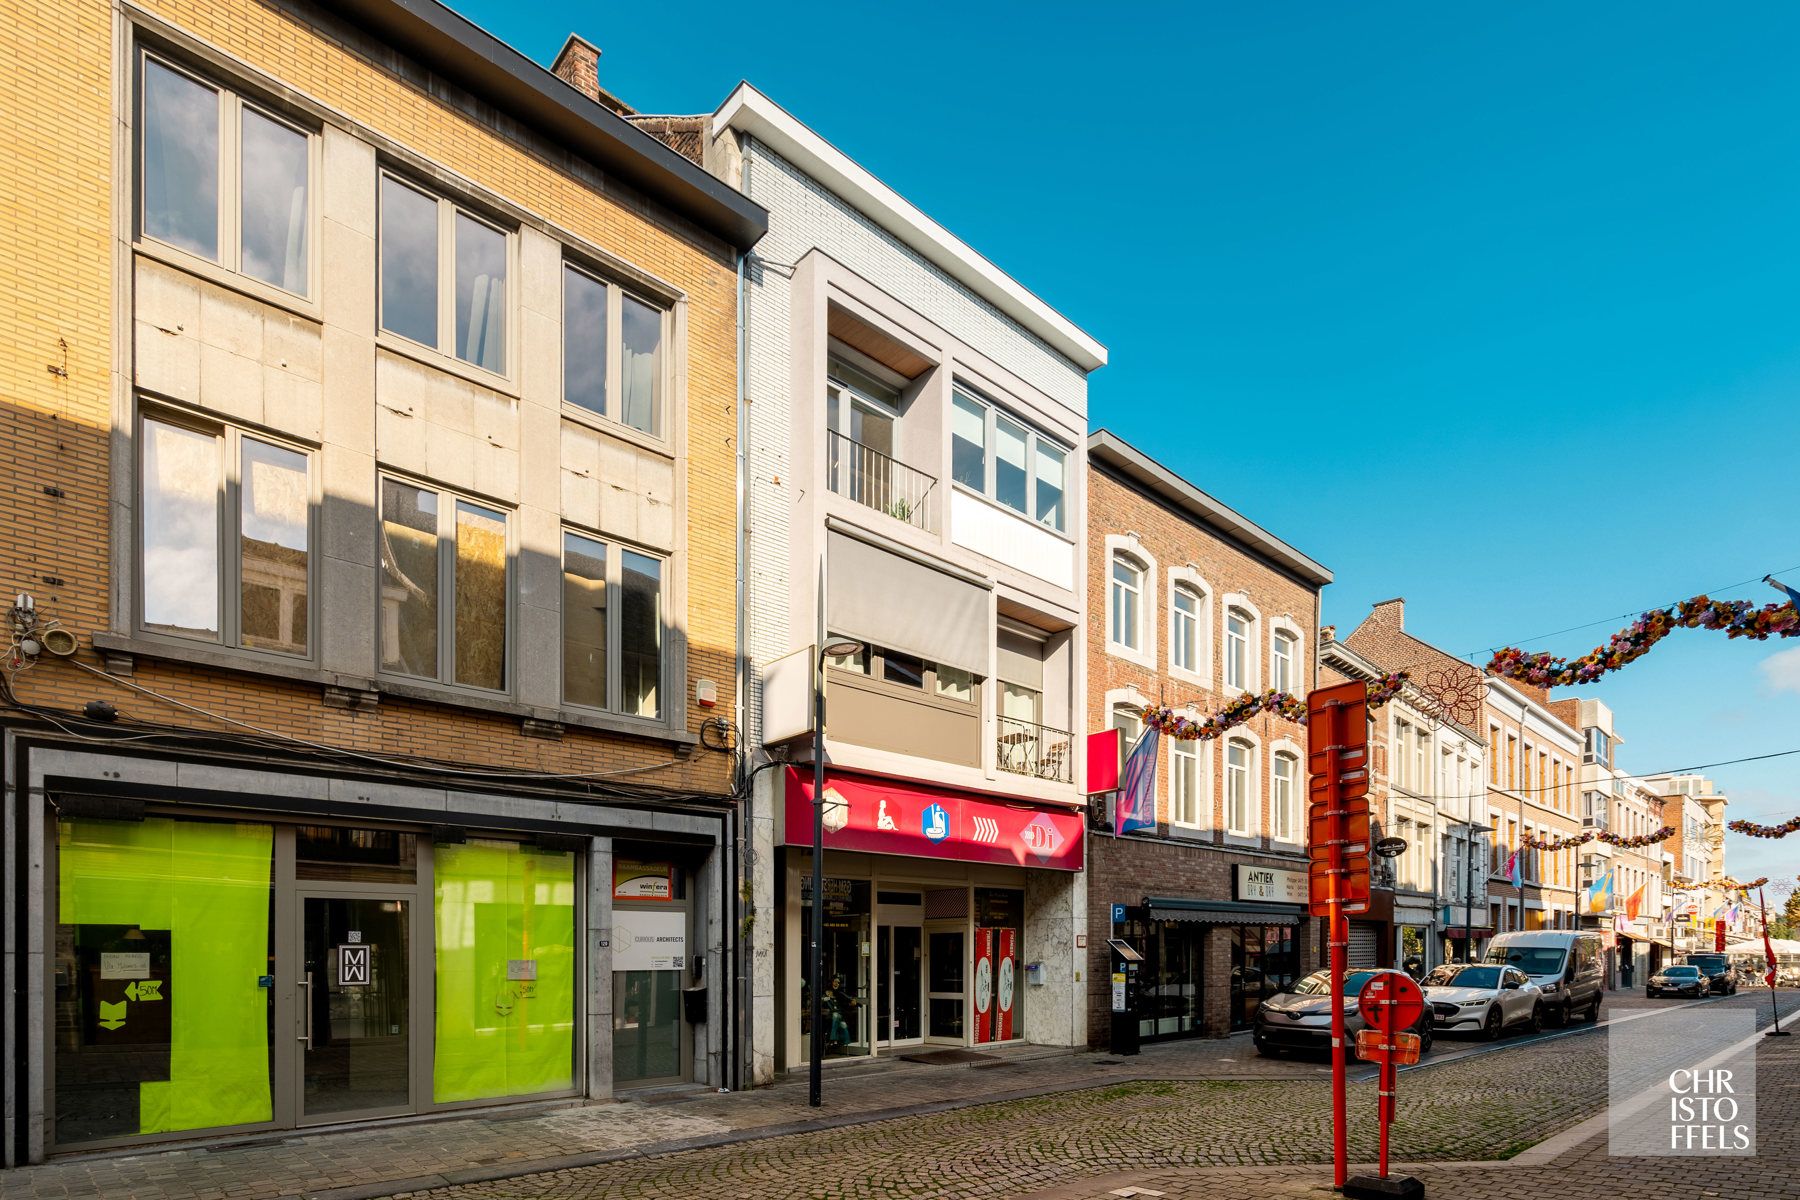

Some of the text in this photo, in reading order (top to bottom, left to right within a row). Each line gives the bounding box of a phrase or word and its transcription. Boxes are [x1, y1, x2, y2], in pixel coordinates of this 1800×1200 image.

[1030, 824, 1054, 849] Di
[1248, 871, 1274, 884] ANTIEK
[640, 881, 667, 892] winfera
[1259, 885, 1264, 897] &
[1115, 907, 1123, 919] P
